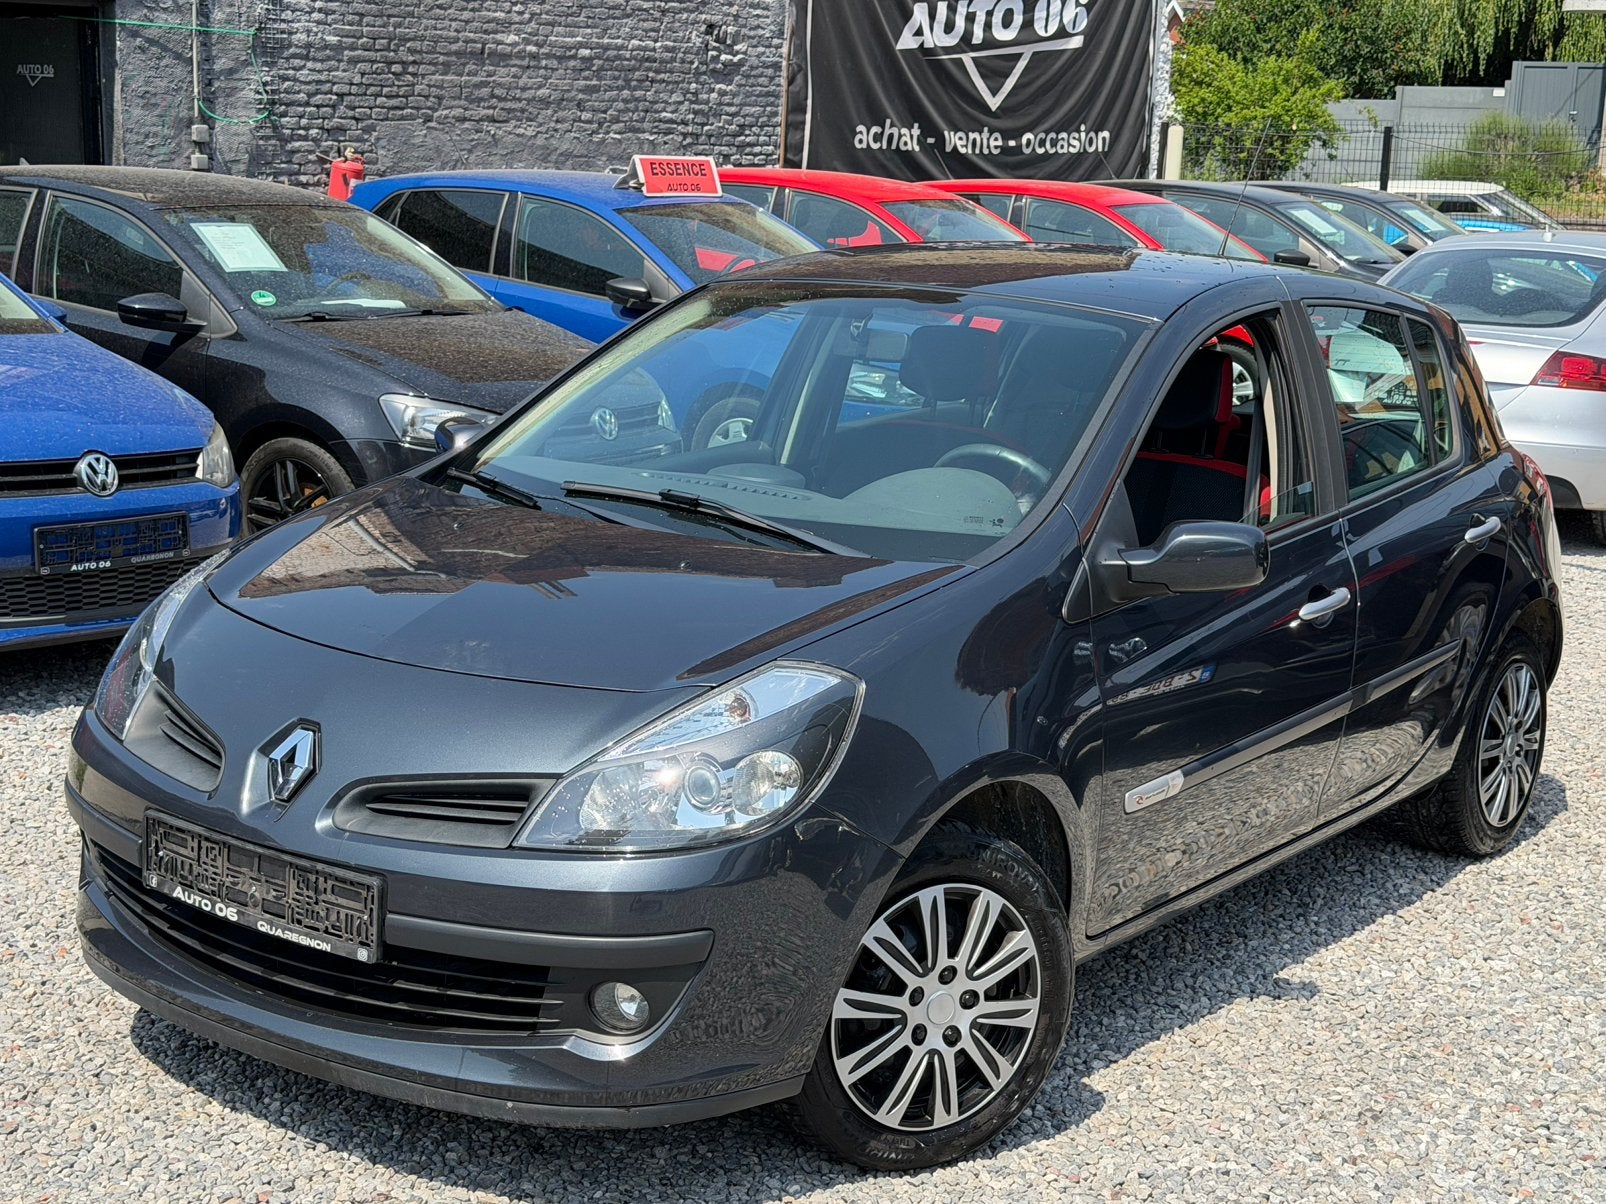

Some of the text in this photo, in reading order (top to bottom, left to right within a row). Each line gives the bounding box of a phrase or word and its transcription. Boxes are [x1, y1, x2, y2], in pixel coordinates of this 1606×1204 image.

[896, 0, 1088, 49] AUTO 06
[17, 64, 54, 74] AUTO 06
[854, 119, 920, 151] achat
[944, 127, 1003, 154] vente
[1022, 124, 1110, 154] occasion
[650, 162, 707, 176] ESSENCE
[667, 183, 701, 192] AUTO 06
[70, 561, 111, 572] AUTO 06
[172, 886, 238, 922] AUTO 06
[257, 920, 331, 952] QUAREGNON
